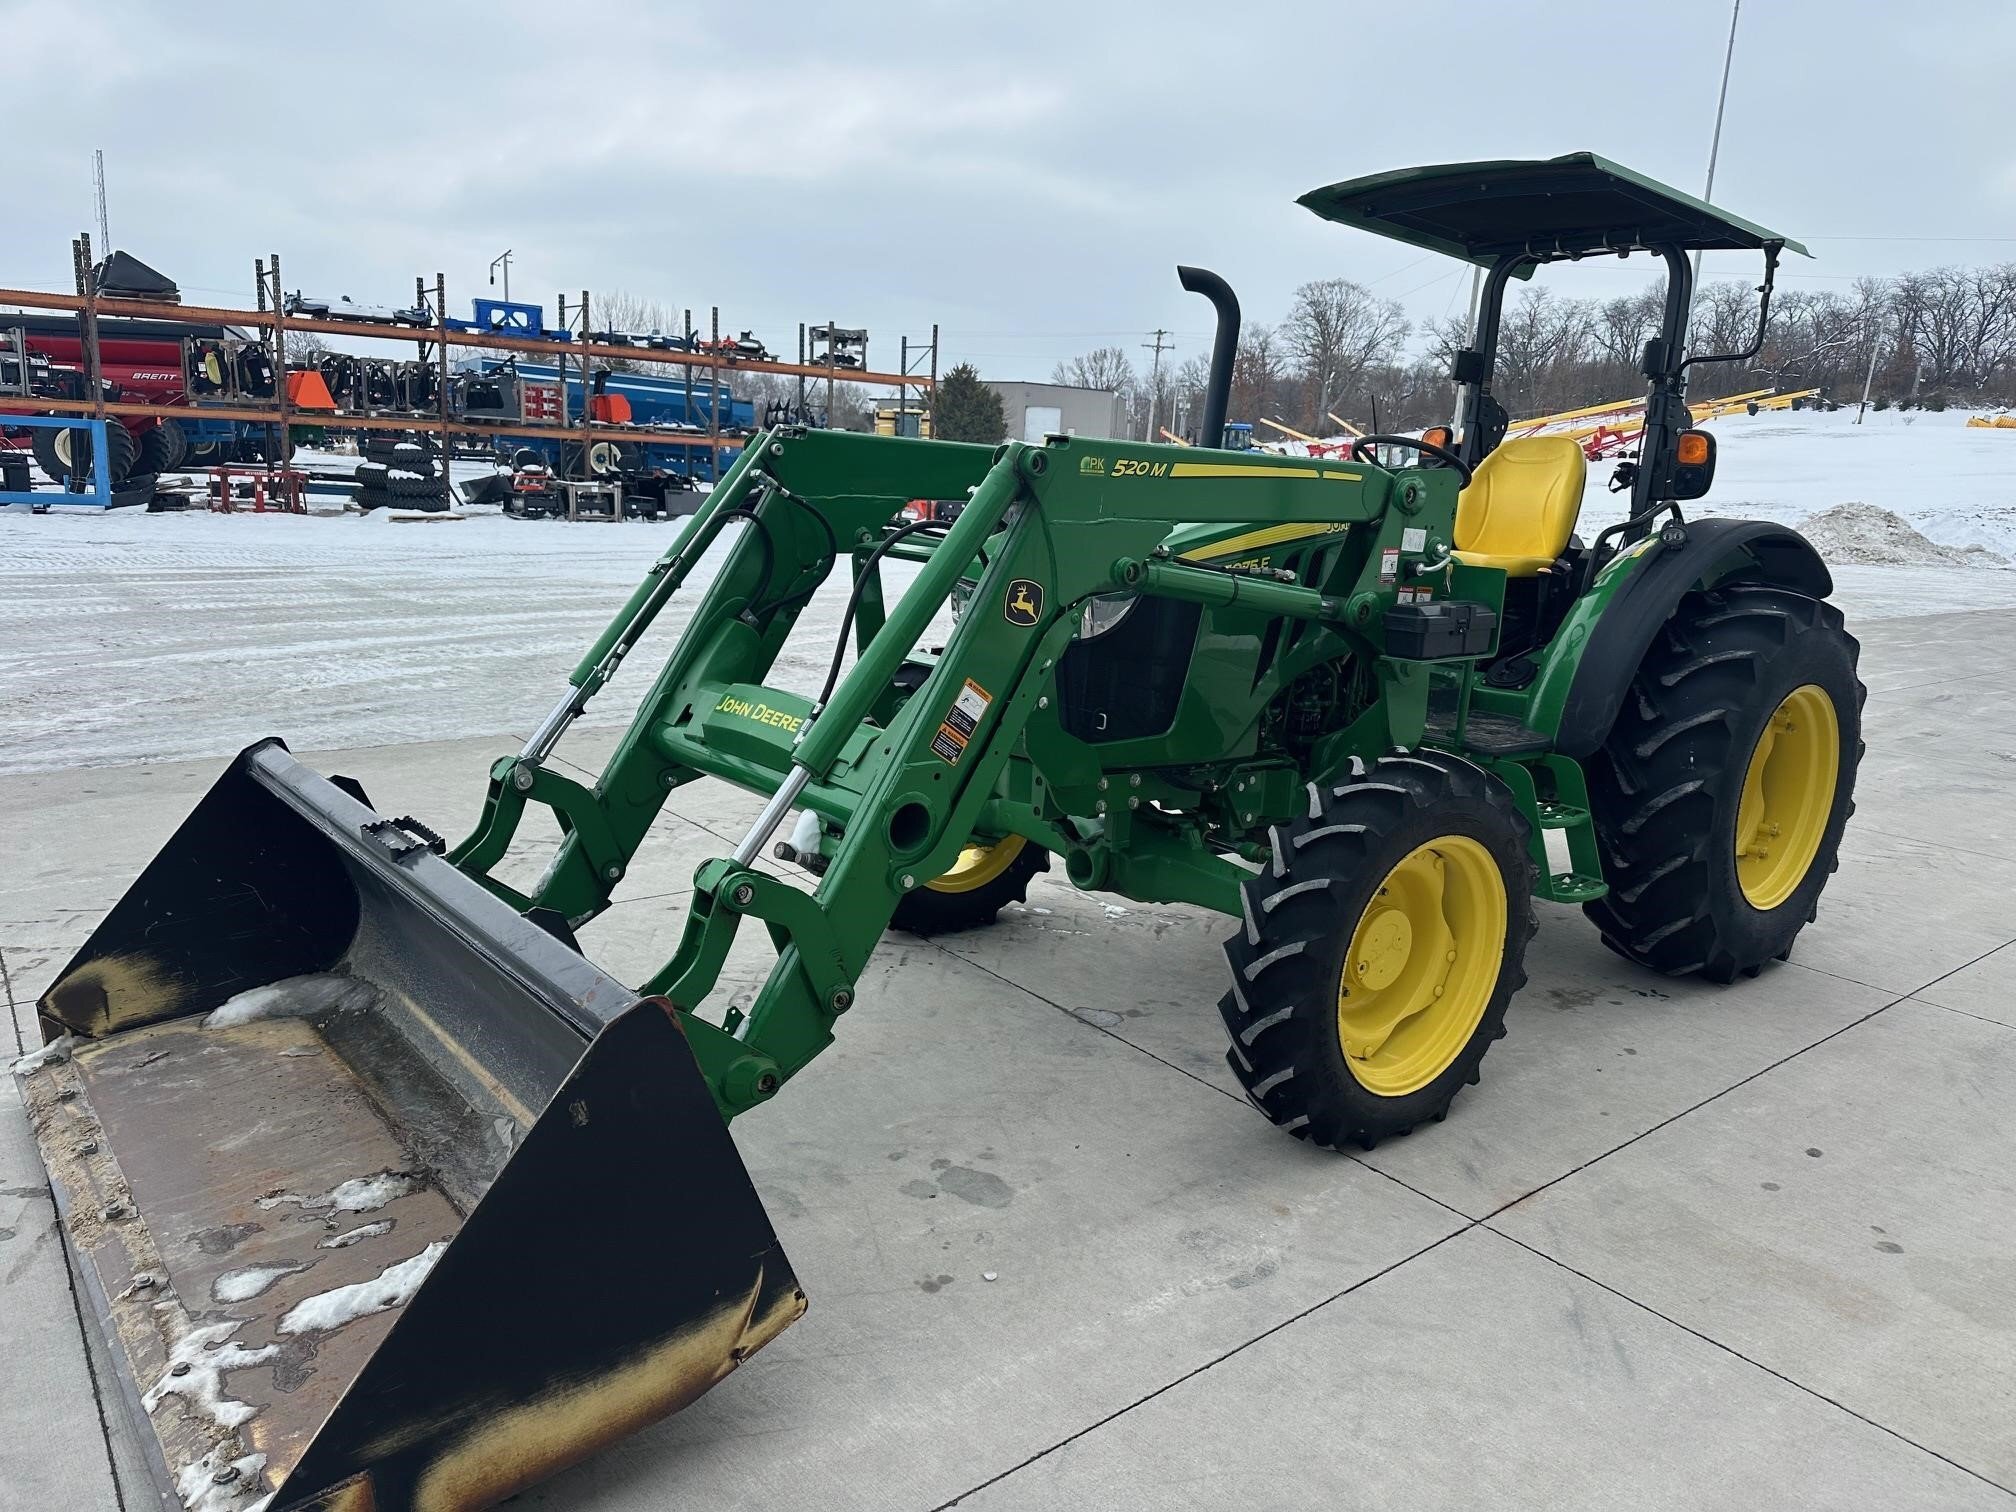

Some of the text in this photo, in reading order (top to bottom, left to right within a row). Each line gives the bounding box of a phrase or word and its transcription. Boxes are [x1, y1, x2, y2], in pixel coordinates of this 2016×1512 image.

[132, 372, 177, 380] BRENT
[715, 695, 803, 733] JOHN DEERE
